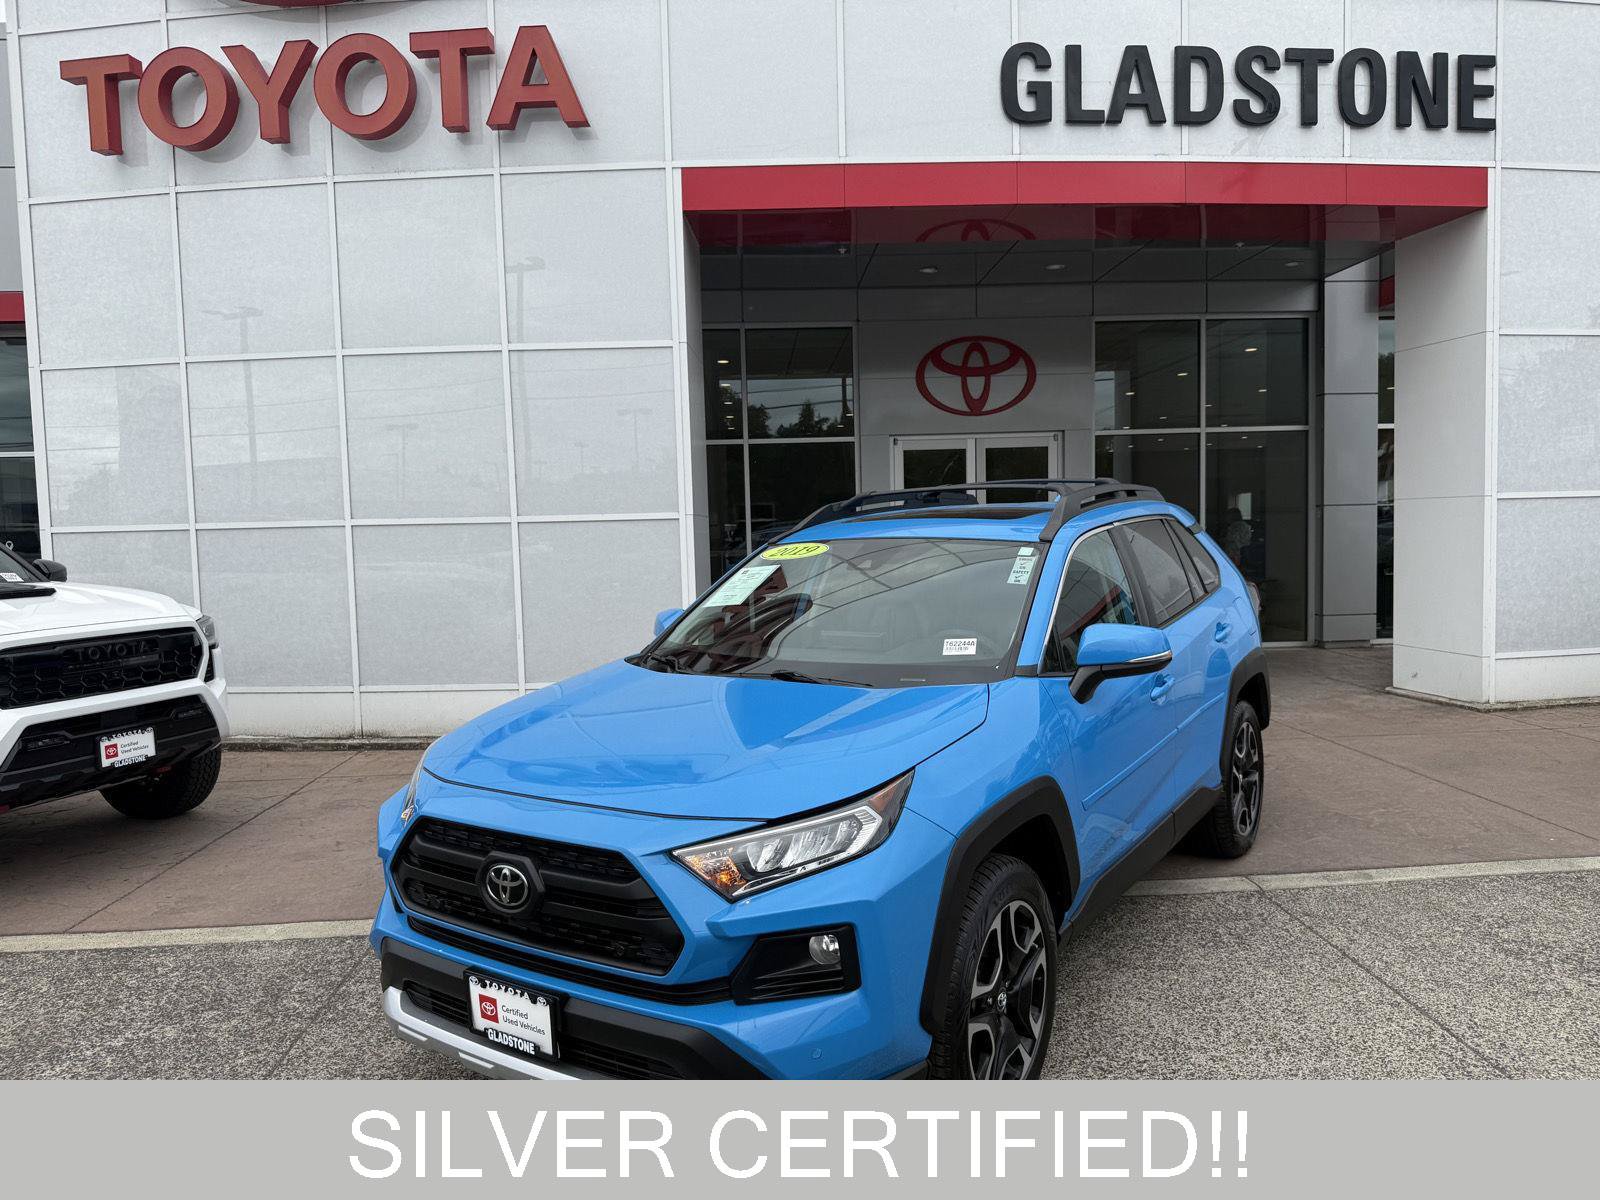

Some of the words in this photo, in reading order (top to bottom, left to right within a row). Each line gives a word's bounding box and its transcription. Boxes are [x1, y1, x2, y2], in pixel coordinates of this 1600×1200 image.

[60, 25, 590, 156] TOYOTA
[1000, 42, 1496, 131] GLADSTONE
[767, 545, 821, 558] 2019
[74, 640, 152, 661] TOYOTA
[112, 729, 142, 739] TOYOTA
[114, 754, 146, 768] GLADSTONE
[484, 980, 530, 1000] TOYOTA
[501, 1005, 529, 1020] Certified
[502, 1015, 519, 1027] Used
[519, 1019, 546, 1036] Vehicles
[487, 1028, 536, 1055] GLADSTONE
